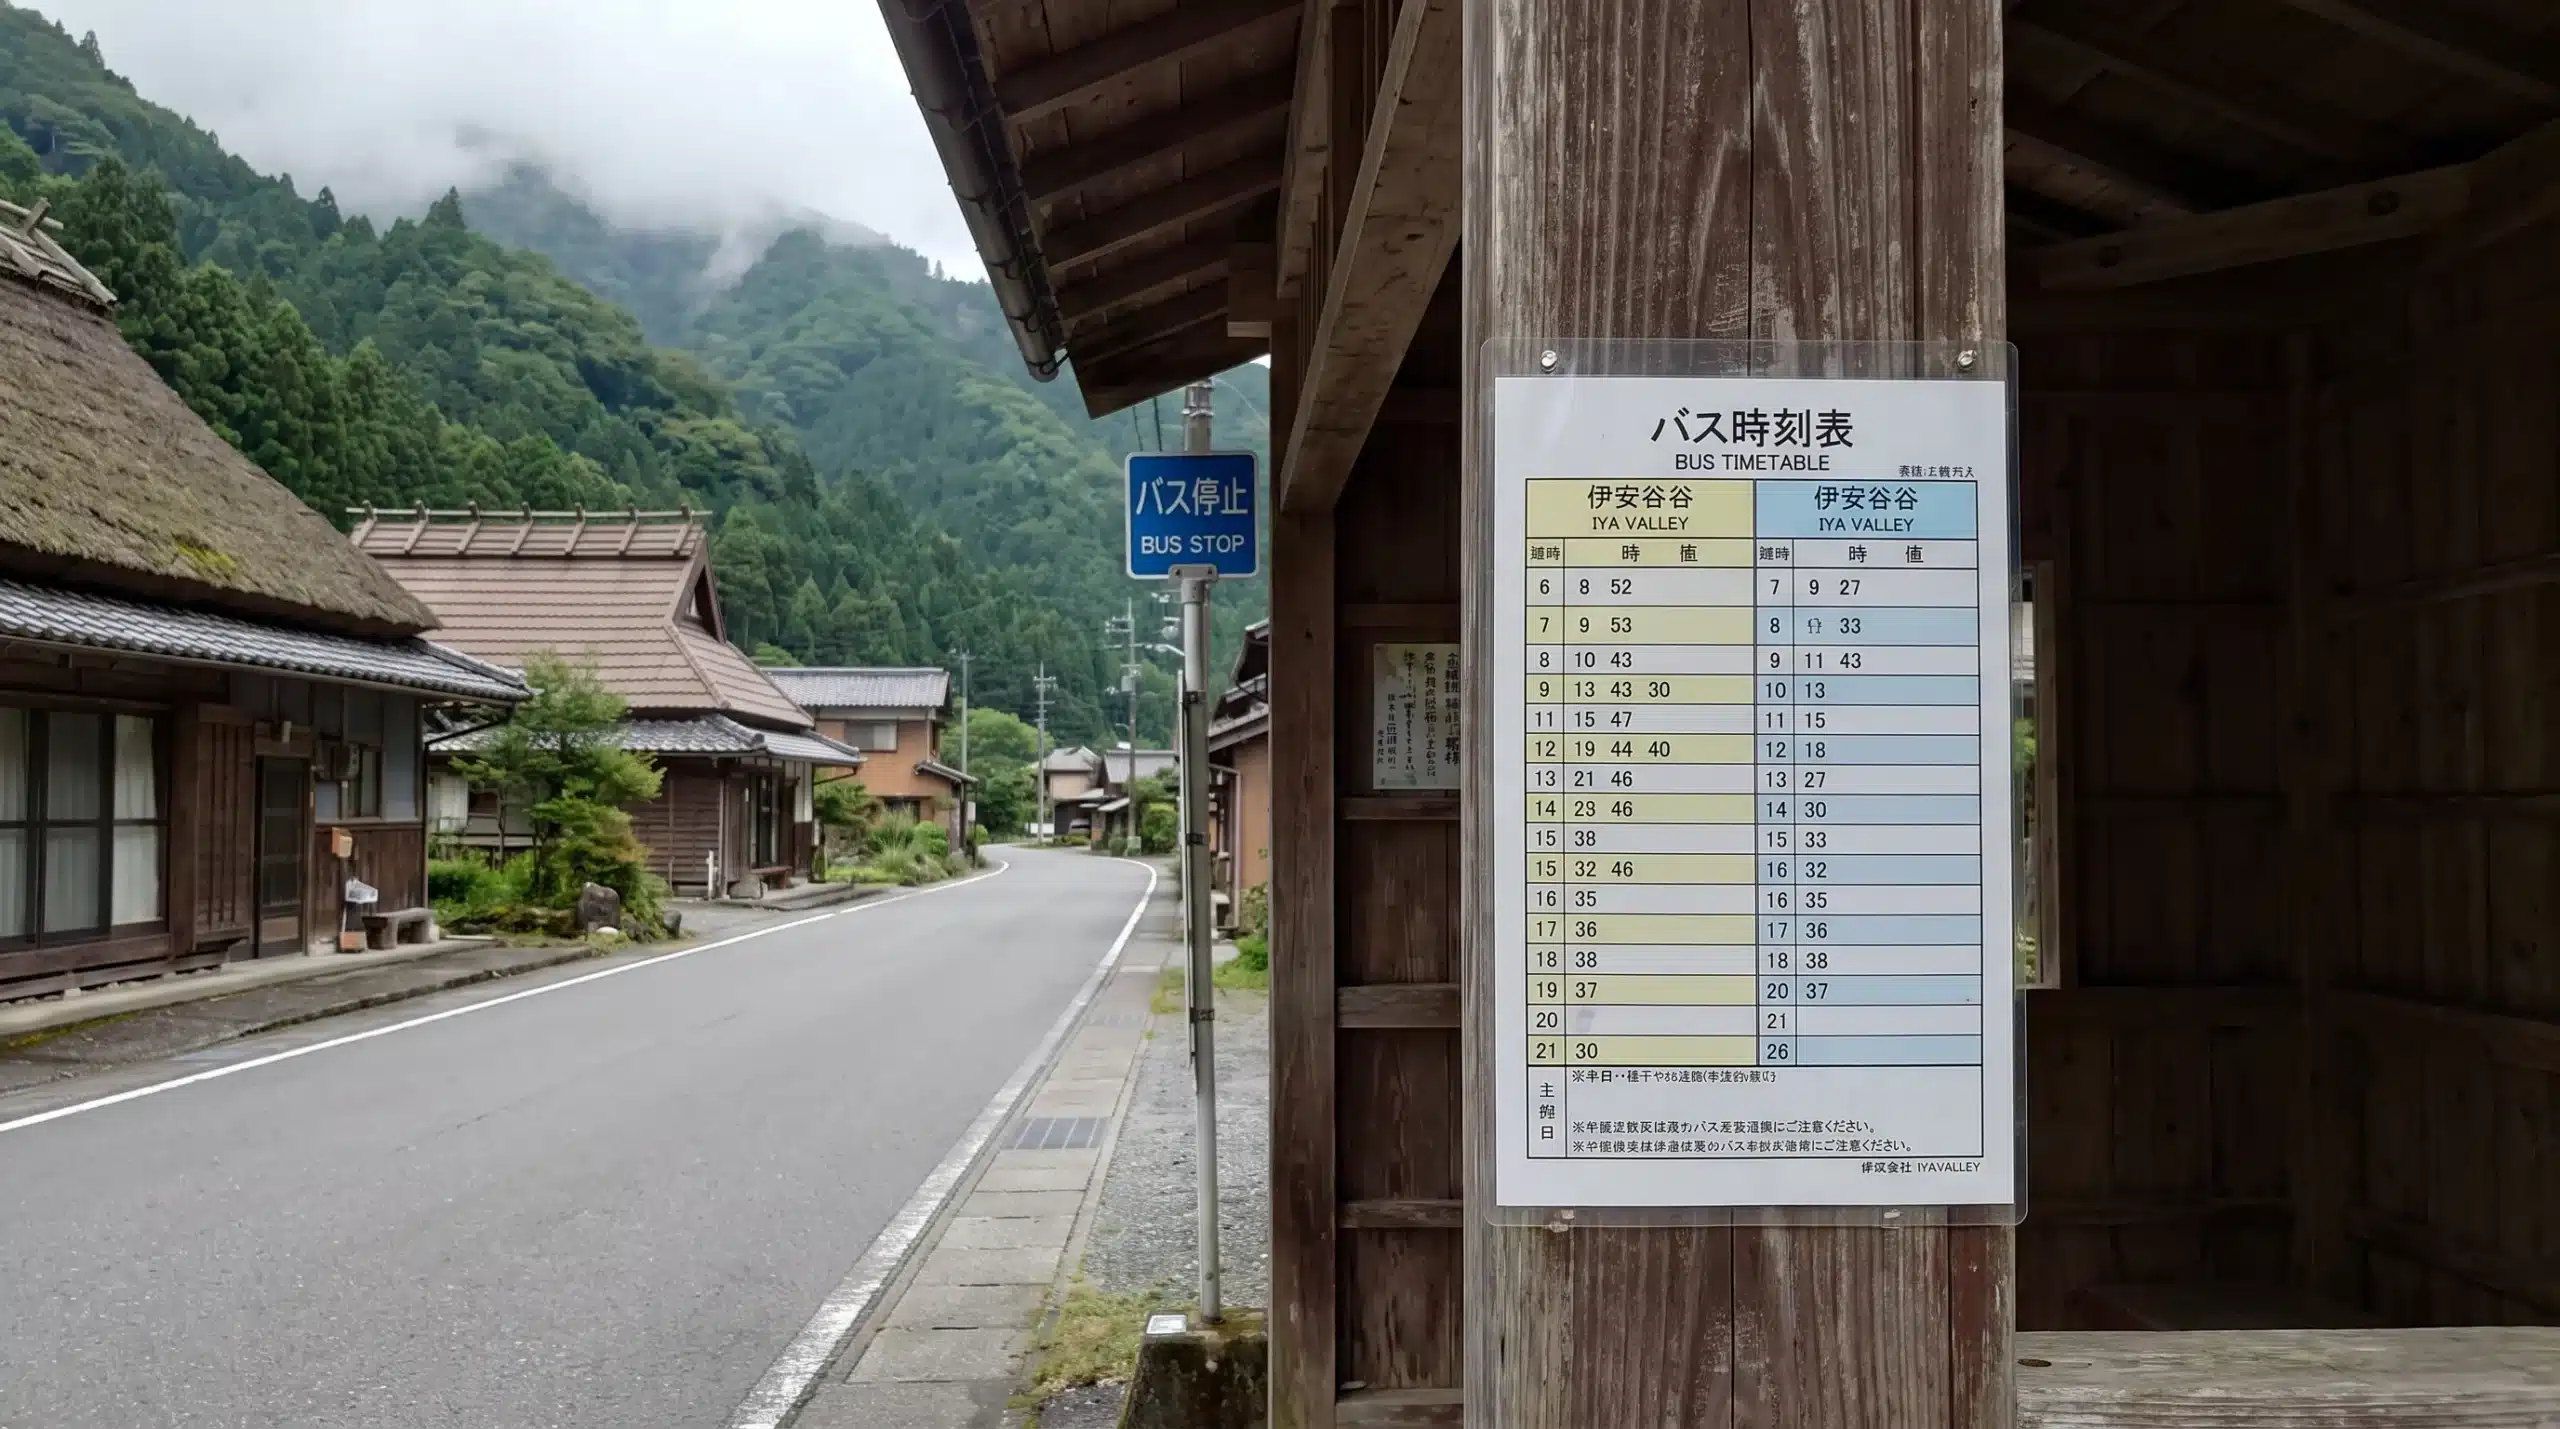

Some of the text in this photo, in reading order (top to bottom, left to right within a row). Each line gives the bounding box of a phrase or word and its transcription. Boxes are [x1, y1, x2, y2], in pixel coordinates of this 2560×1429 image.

[1650, 406, 1854, 449] バス時刻表
[1675, 453, 1831, 472] BUS TIMETABLE
[1135, 476, 1249, 516] バス停止
[1587, 483, 1694, 510] 伊安谷谷
[1813, 484, 1919, 511] 伊安谷谷
[1592, 516, 1689, 531] IYA VALLEY
[1818, 517, 1915, 533] IYA VALLEY
[1141, 535, 1245, 555] BUS STOP
[1539, 578, 1632, 596] 6 8 52
[1769, 578, 1861, 596] 7 9 27
[1539, 616, 1632, 634] 7 9 53
[1769, 617, 1781, 634] 8
[1839, 617, 1861, 635] 33
[1539, 651, 1632, 668] 8 10 43
[1770, 651, 1862, 669] 9 11 43
[1539, 680, 1671, 698] 9 13 43 30
[1765, 681, 1826, 699] 10 13
[1535, 710, 1633, 728] 11 15 47
[1765, 711, 1826, 729] 11 15
[1534, 740, 1671, 758] 12 19 44 40
[1765, 741, 1826, 759] 12 18
[1534, 769, 1633, 788] 13 21 46
[1765, 771, 1826, 788] 13 27
[1535, 799, 1557, 817] 14
[1610, 800, 1633, 818] 46
[1765, 801, 1827, 819] 14 30
[1535, 829, 1597, 847] 15 38
[1766, 831, 1827, 849] 15 33
[1535, 859, 1634, 878] 15 32 46
[1766, 861, 1827, 879] 16 32
[1536, 890, 1597, 908] 16 35
[1767, 891, 1828, 909] 16 35
[1536, 920, 1597, 938] 17 36
[1767, 921, 1828, 939] 17 36
[1536, 950, 1598, 969] 18 38
[1767, 951, 1828, 970] 18 38
[1536, 981, 1598, 999] 19 37
[1766, 982, 1829, 1000] 20 37
[1535, 1011, 1558, 1029] 20
[1766, 1012, 1786, 1030] 21
[1535, 1042, 1599, 1060] 21 30
[1766, 1042, 1789, 1060] 26
[1917, 1161, 1981, 1173] IYAVALLEY
